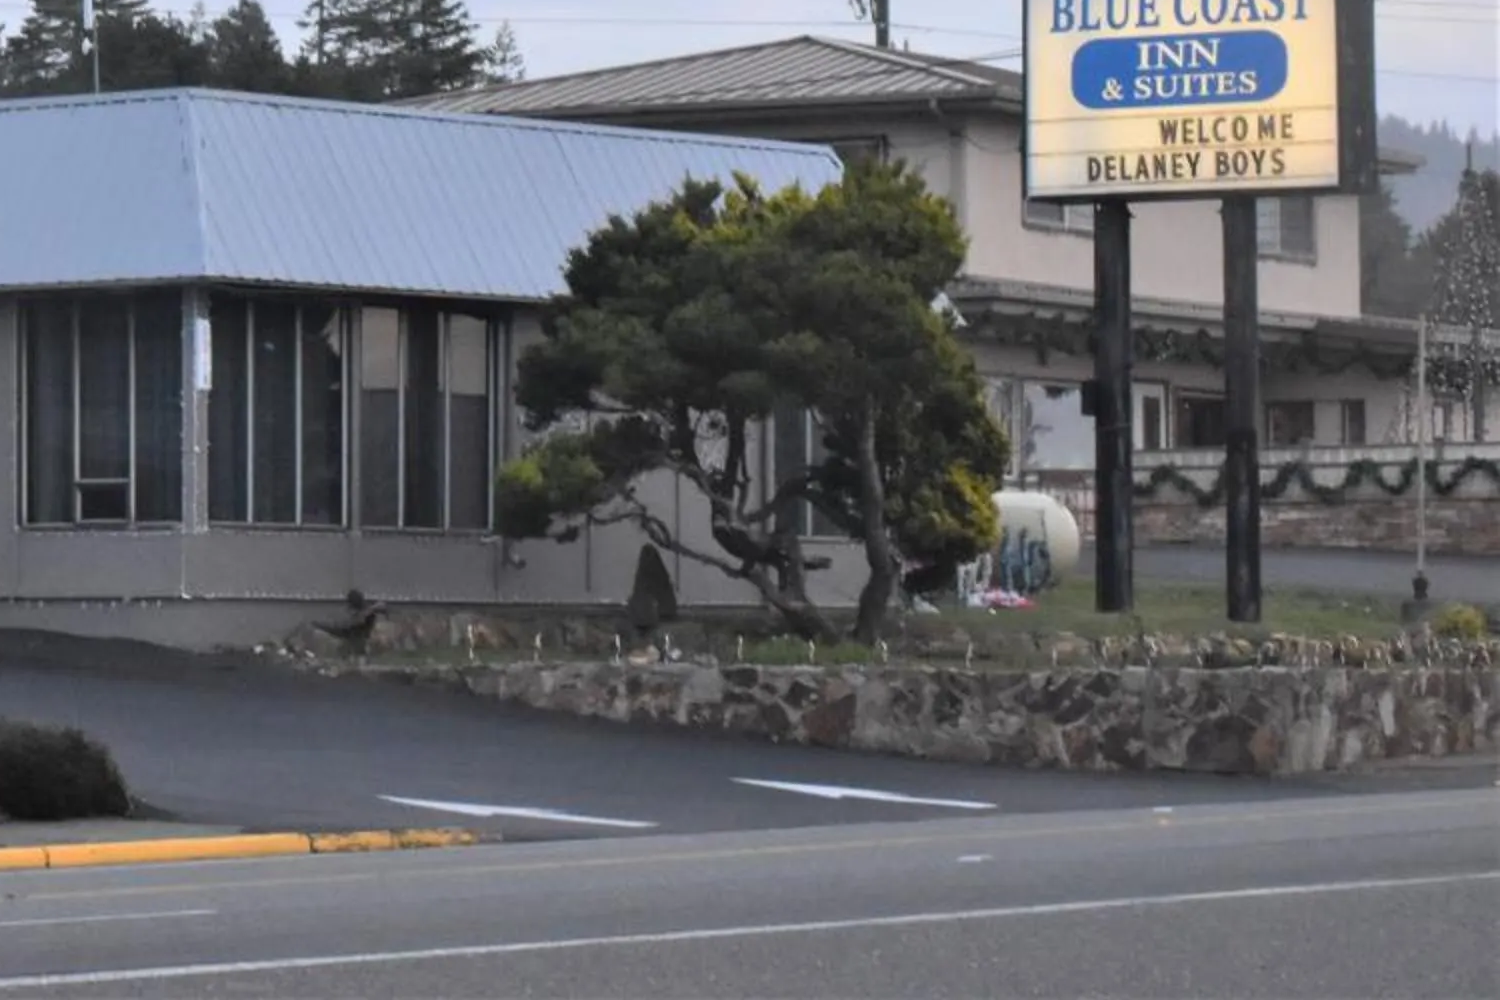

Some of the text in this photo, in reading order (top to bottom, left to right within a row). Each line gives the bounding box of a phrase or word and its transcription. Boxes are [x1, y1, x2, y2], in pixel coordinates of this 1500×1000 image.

[1136, 37, 1220, 70] INN
[1101, 70, 1257, 101] & SUITES
[1159, 113, 1295, 145] WELCOME
[1087, 148, 1286, 183] DELANEY BOYS
